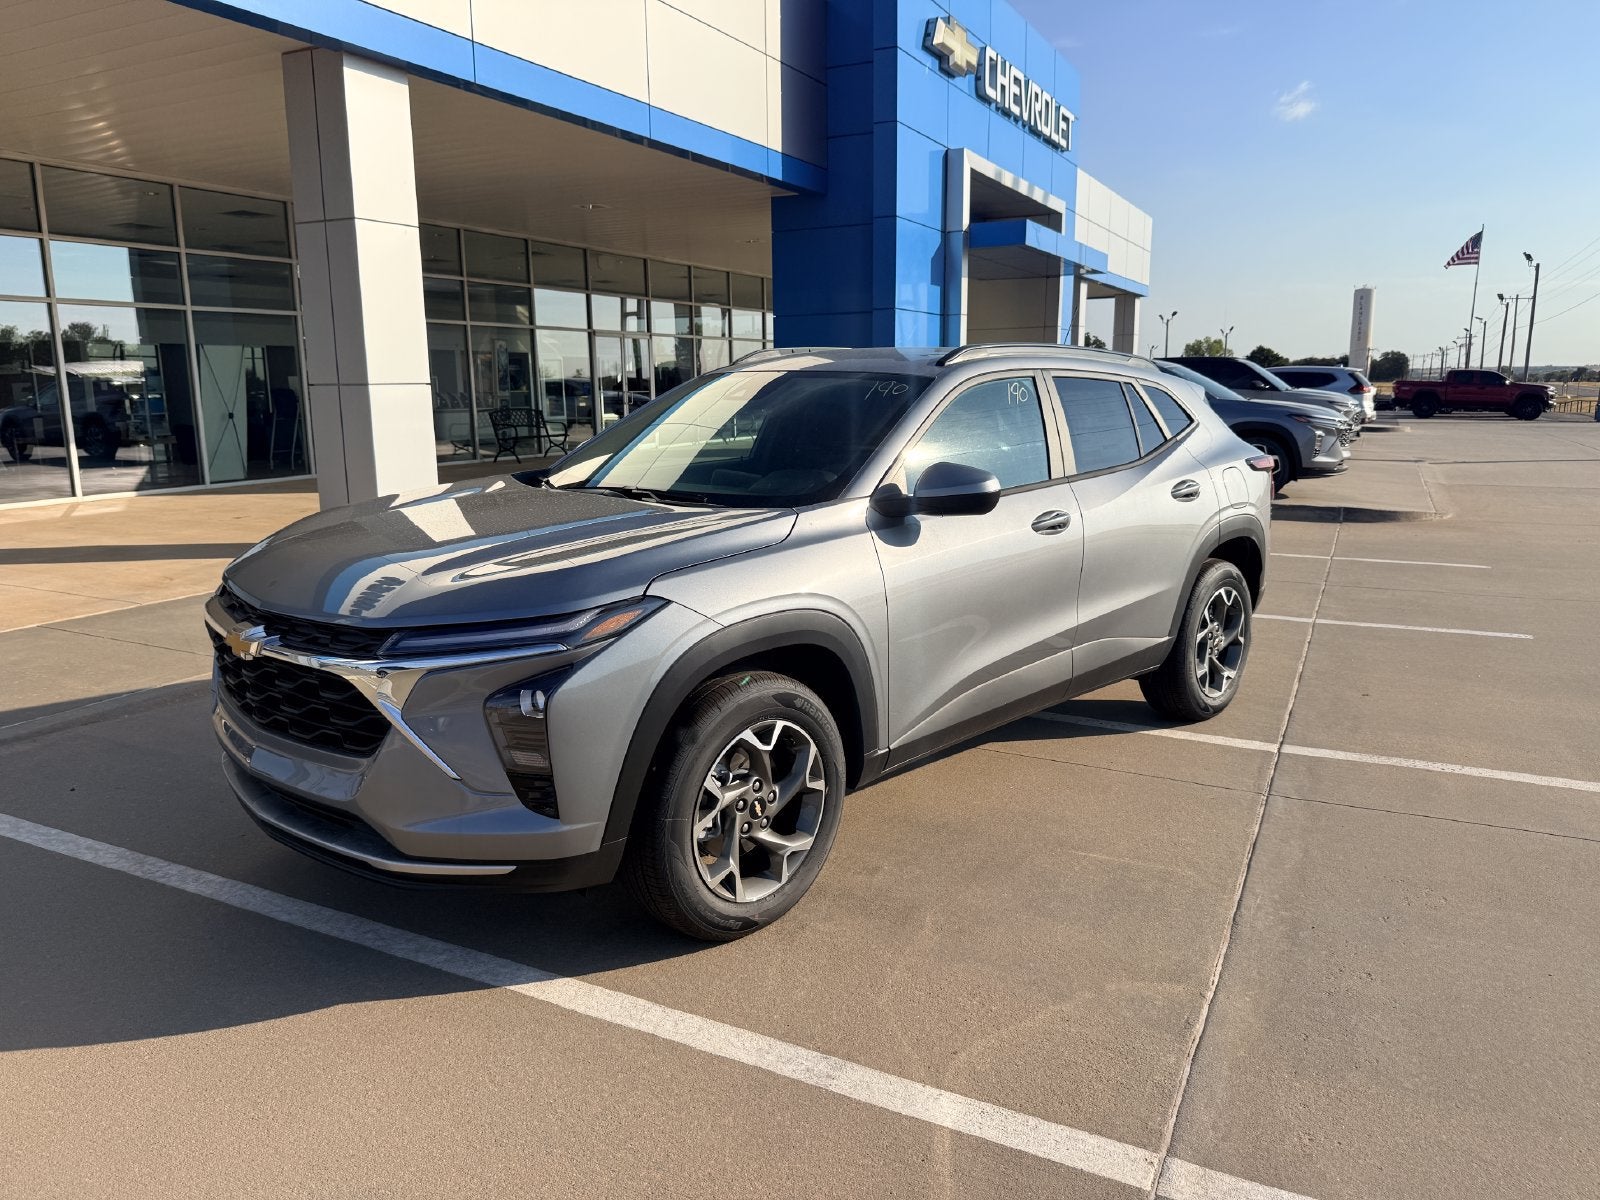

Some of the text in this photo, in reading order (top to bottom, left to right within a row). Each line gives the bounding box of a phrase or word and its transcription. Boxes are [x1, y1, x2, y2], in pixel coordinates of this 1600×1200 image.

[984, 45, 1075, 151] CHEVROLET
[865, 380, 909, 400] 190
[1007, 382, 1029, 405] 190
[802, 701, 837, 745] Hankoo
